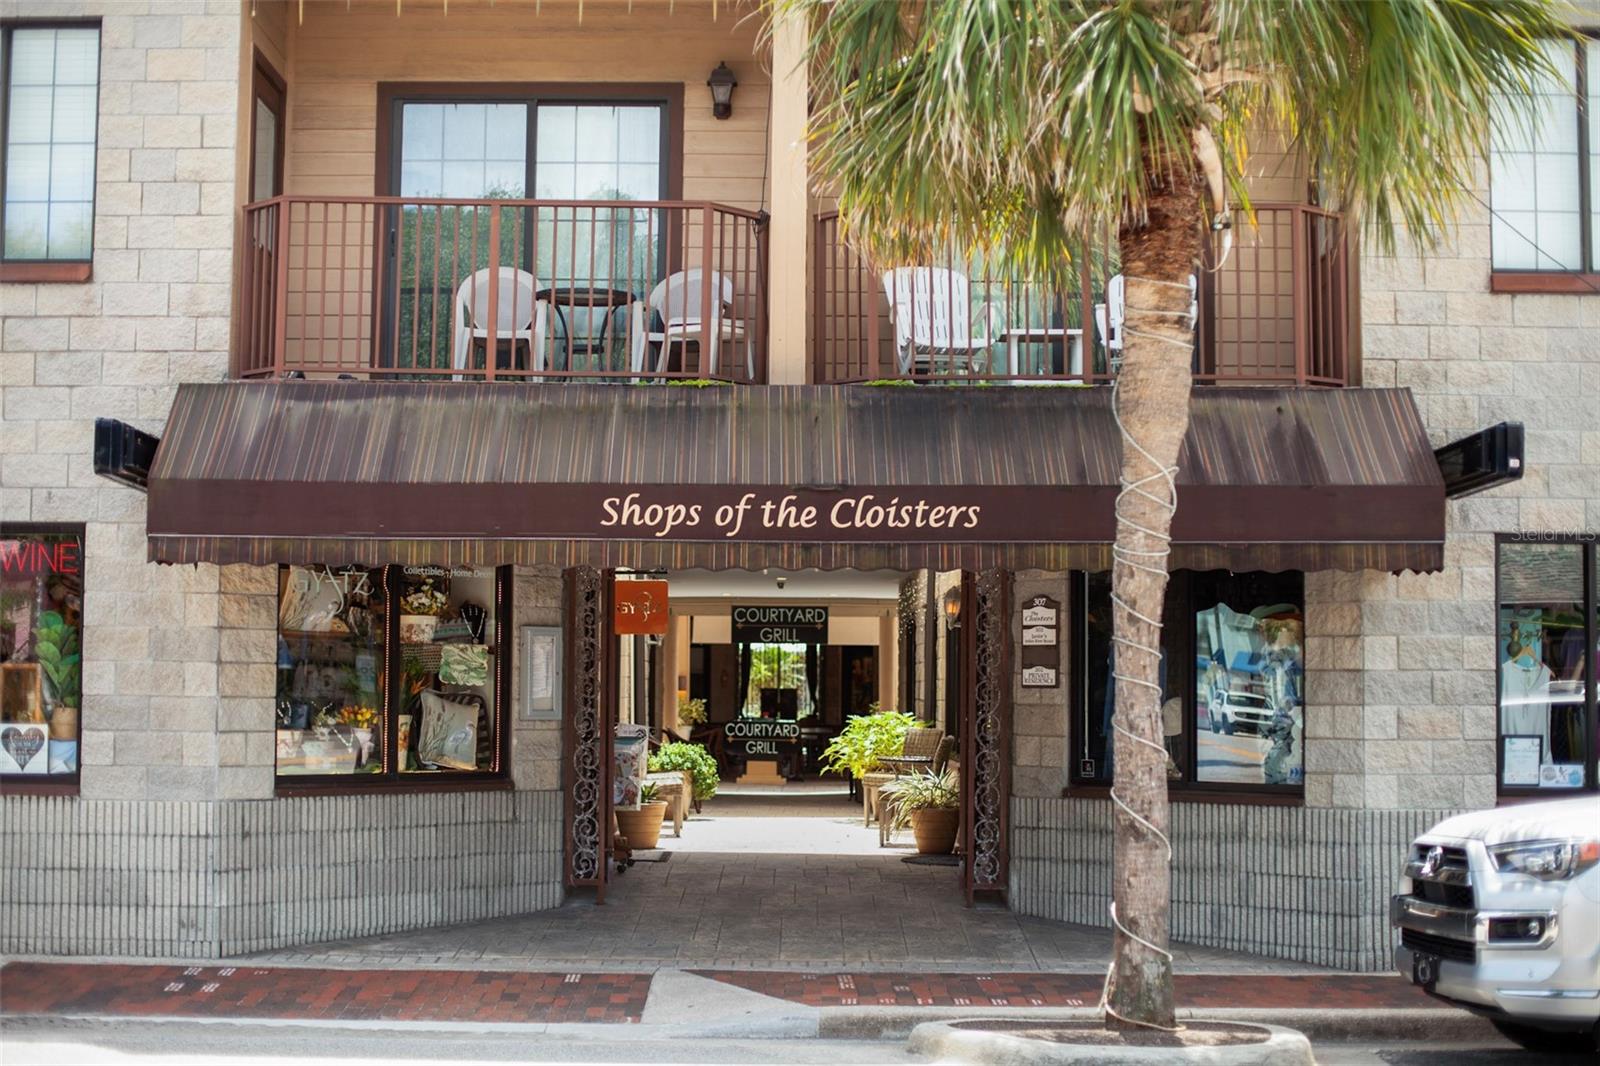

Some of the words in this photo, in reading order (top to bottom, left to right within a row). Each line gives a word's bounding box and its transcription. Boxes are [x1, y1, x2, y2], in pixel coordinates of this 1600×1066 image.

[600, 493, 702, 537] Shops
[714, 493, 756, 537] of
[761, 494, 817, 528] the
[830, 494, 981, 529] Cloisters
[0, 543, 79, 573] WINE
[403, 566, 445, 577] Collectibles
[451, 568, 473, 578] Home
[734, 607, 826, 623] COURTYARD
[759, 627, 800, 642] GRILL
[724, 722, 800, 737] COURTYARD
[745, 740, 778, 754] GRILL
